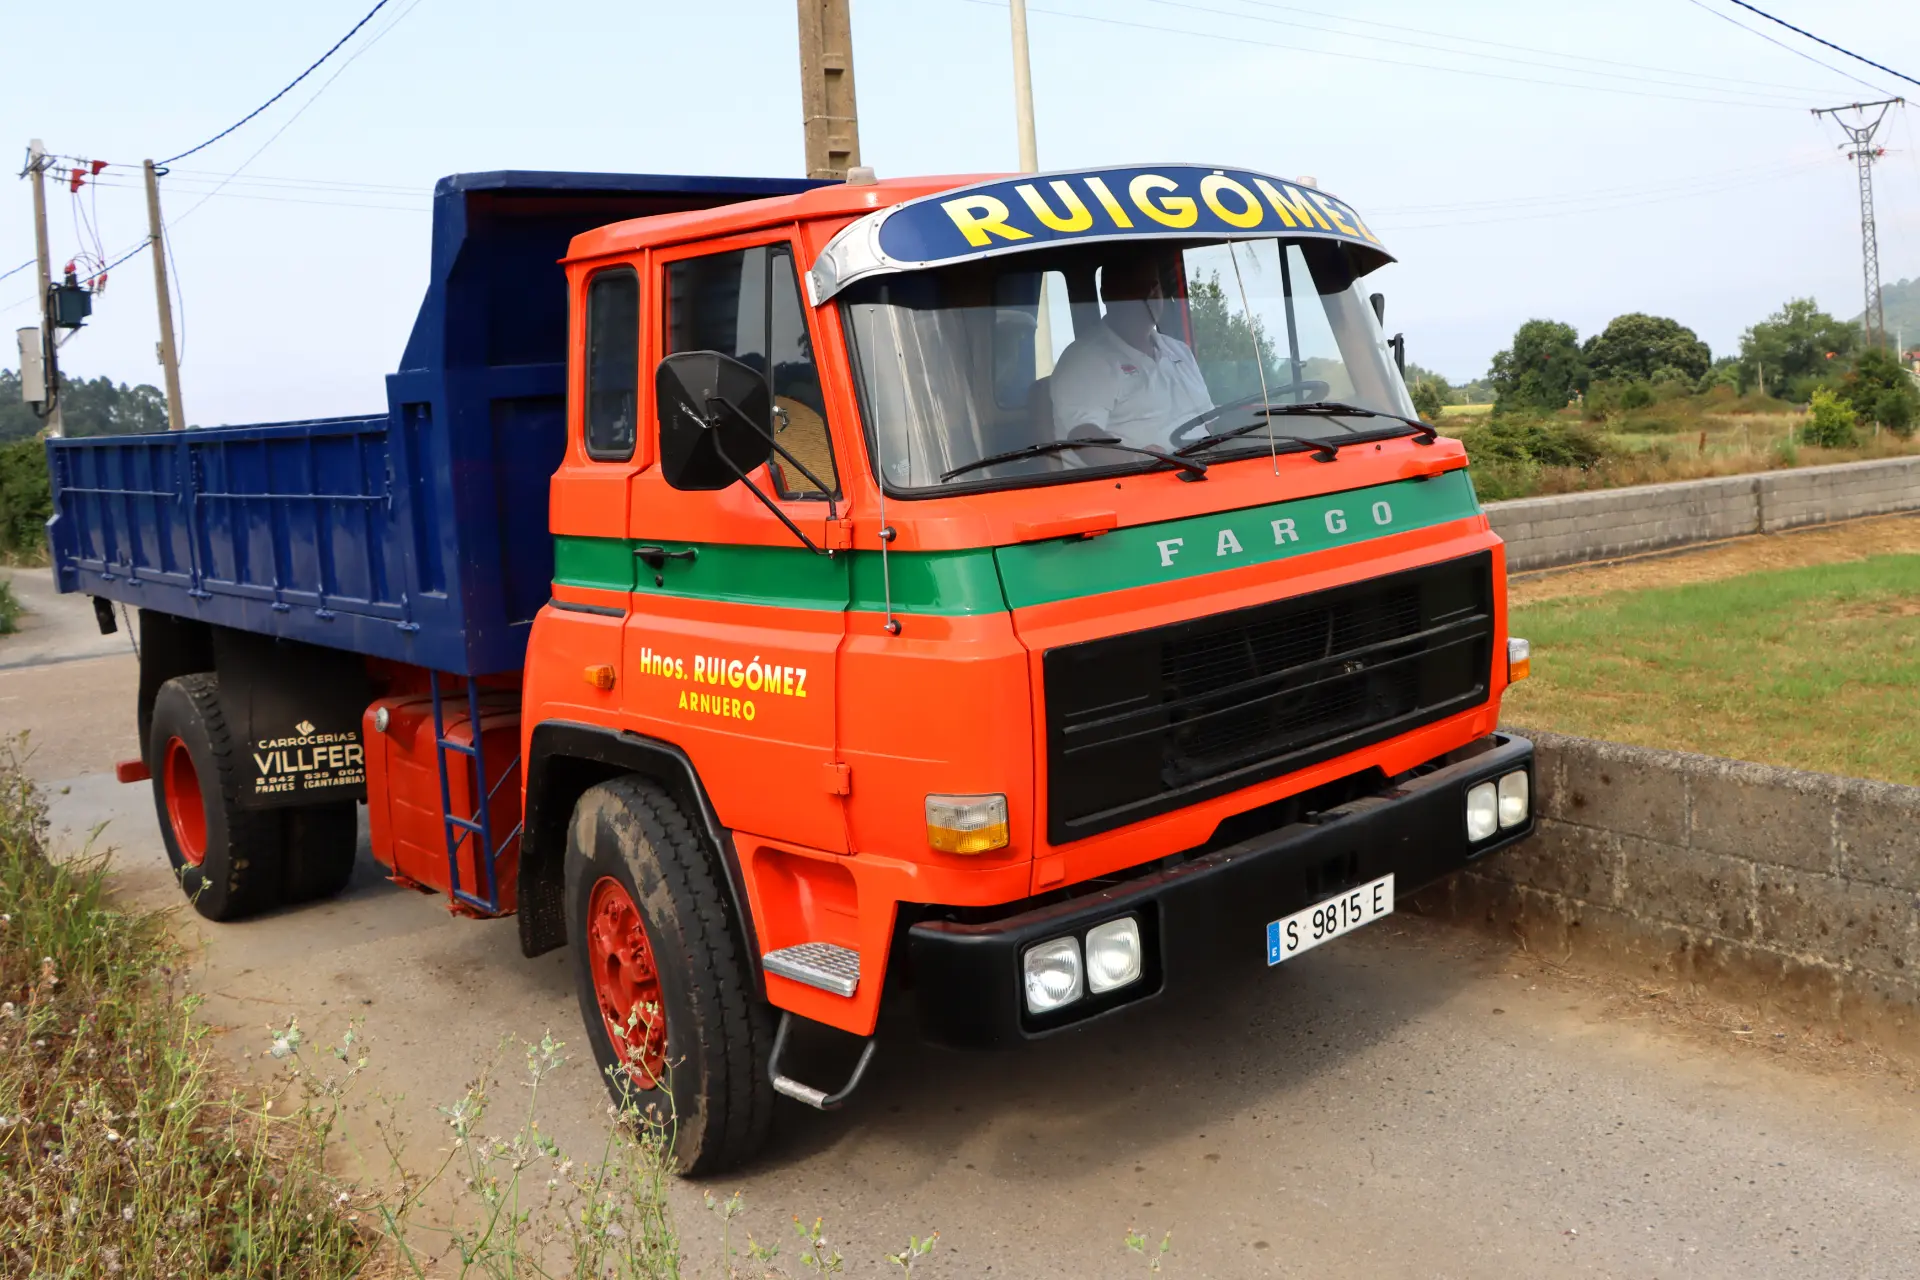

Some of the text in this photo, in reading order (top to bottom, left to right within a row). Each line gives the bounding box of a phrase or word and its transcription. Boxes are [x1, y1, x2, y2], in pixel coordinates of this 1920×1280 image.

[940, 170, 1381, 247] RUIGÓMEZ
[1156, 501, 1393, 567] FARGO
[640, 647, 807, 697] Hnos. RUIGÓMEZ
[678, 690, 756, 721] ARNUERO
[258, 732, 357, 749] CARROCERIAS
[253, 743, 364, 775] VILLFER
[303, 775, 365, 789] (CANTABRIA)
[1286, 883, 1385, 951] S 9815 E
[1271, 947, 1278, 957] E
